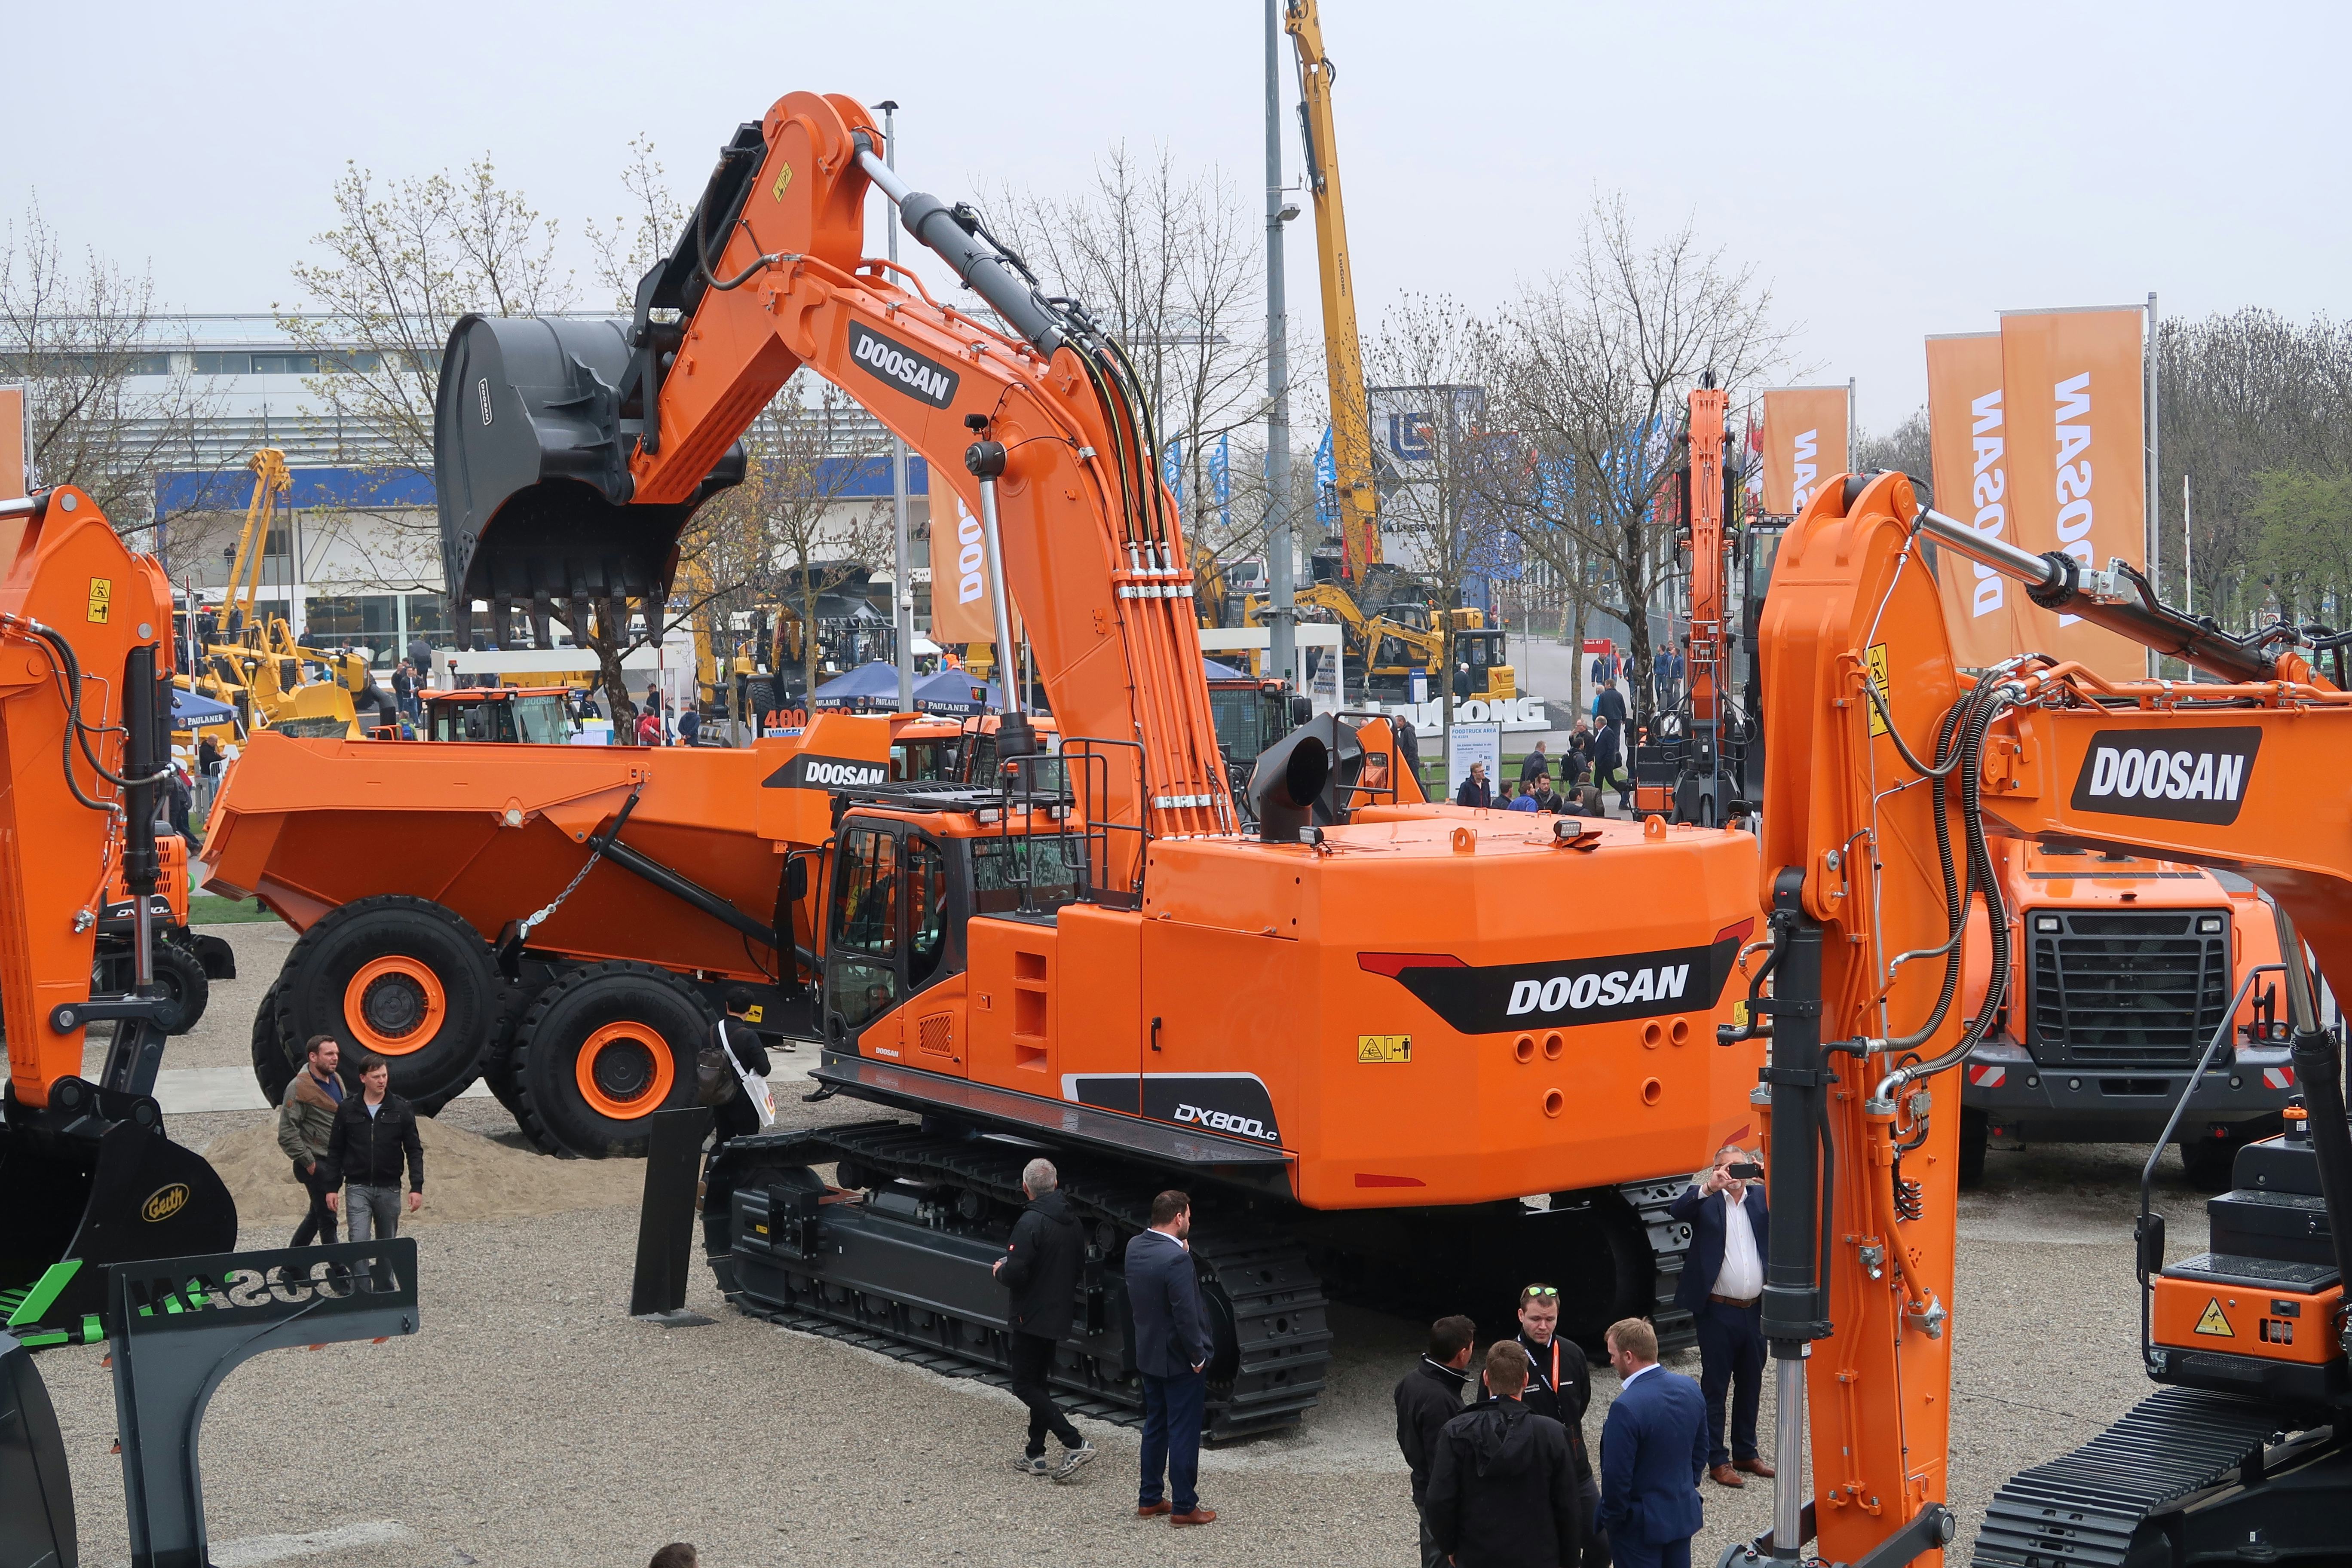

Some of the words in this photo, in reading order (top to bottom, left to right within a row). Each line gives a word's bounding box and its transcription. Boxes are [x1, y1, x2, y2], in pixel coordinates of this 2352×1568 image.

[855, 334, 950, 401] DOOSAN
[481, 383, 489, 420] DOOSAN
[875, 697, 899, 707] PAULANE
[928, 701, 970, 712] PAULANER
[187, 714, 224, 726] PAULANER
[805, 761, 885, 785] DOOSAN
[2089, 747, 2244, 801] DOOSAN
[1506, 964, 1690, 1016] DOOSAN
[876, 1047, 899, 1057] DOOSAN
[1525, 1349, 1537, 1366] DOOSAN
